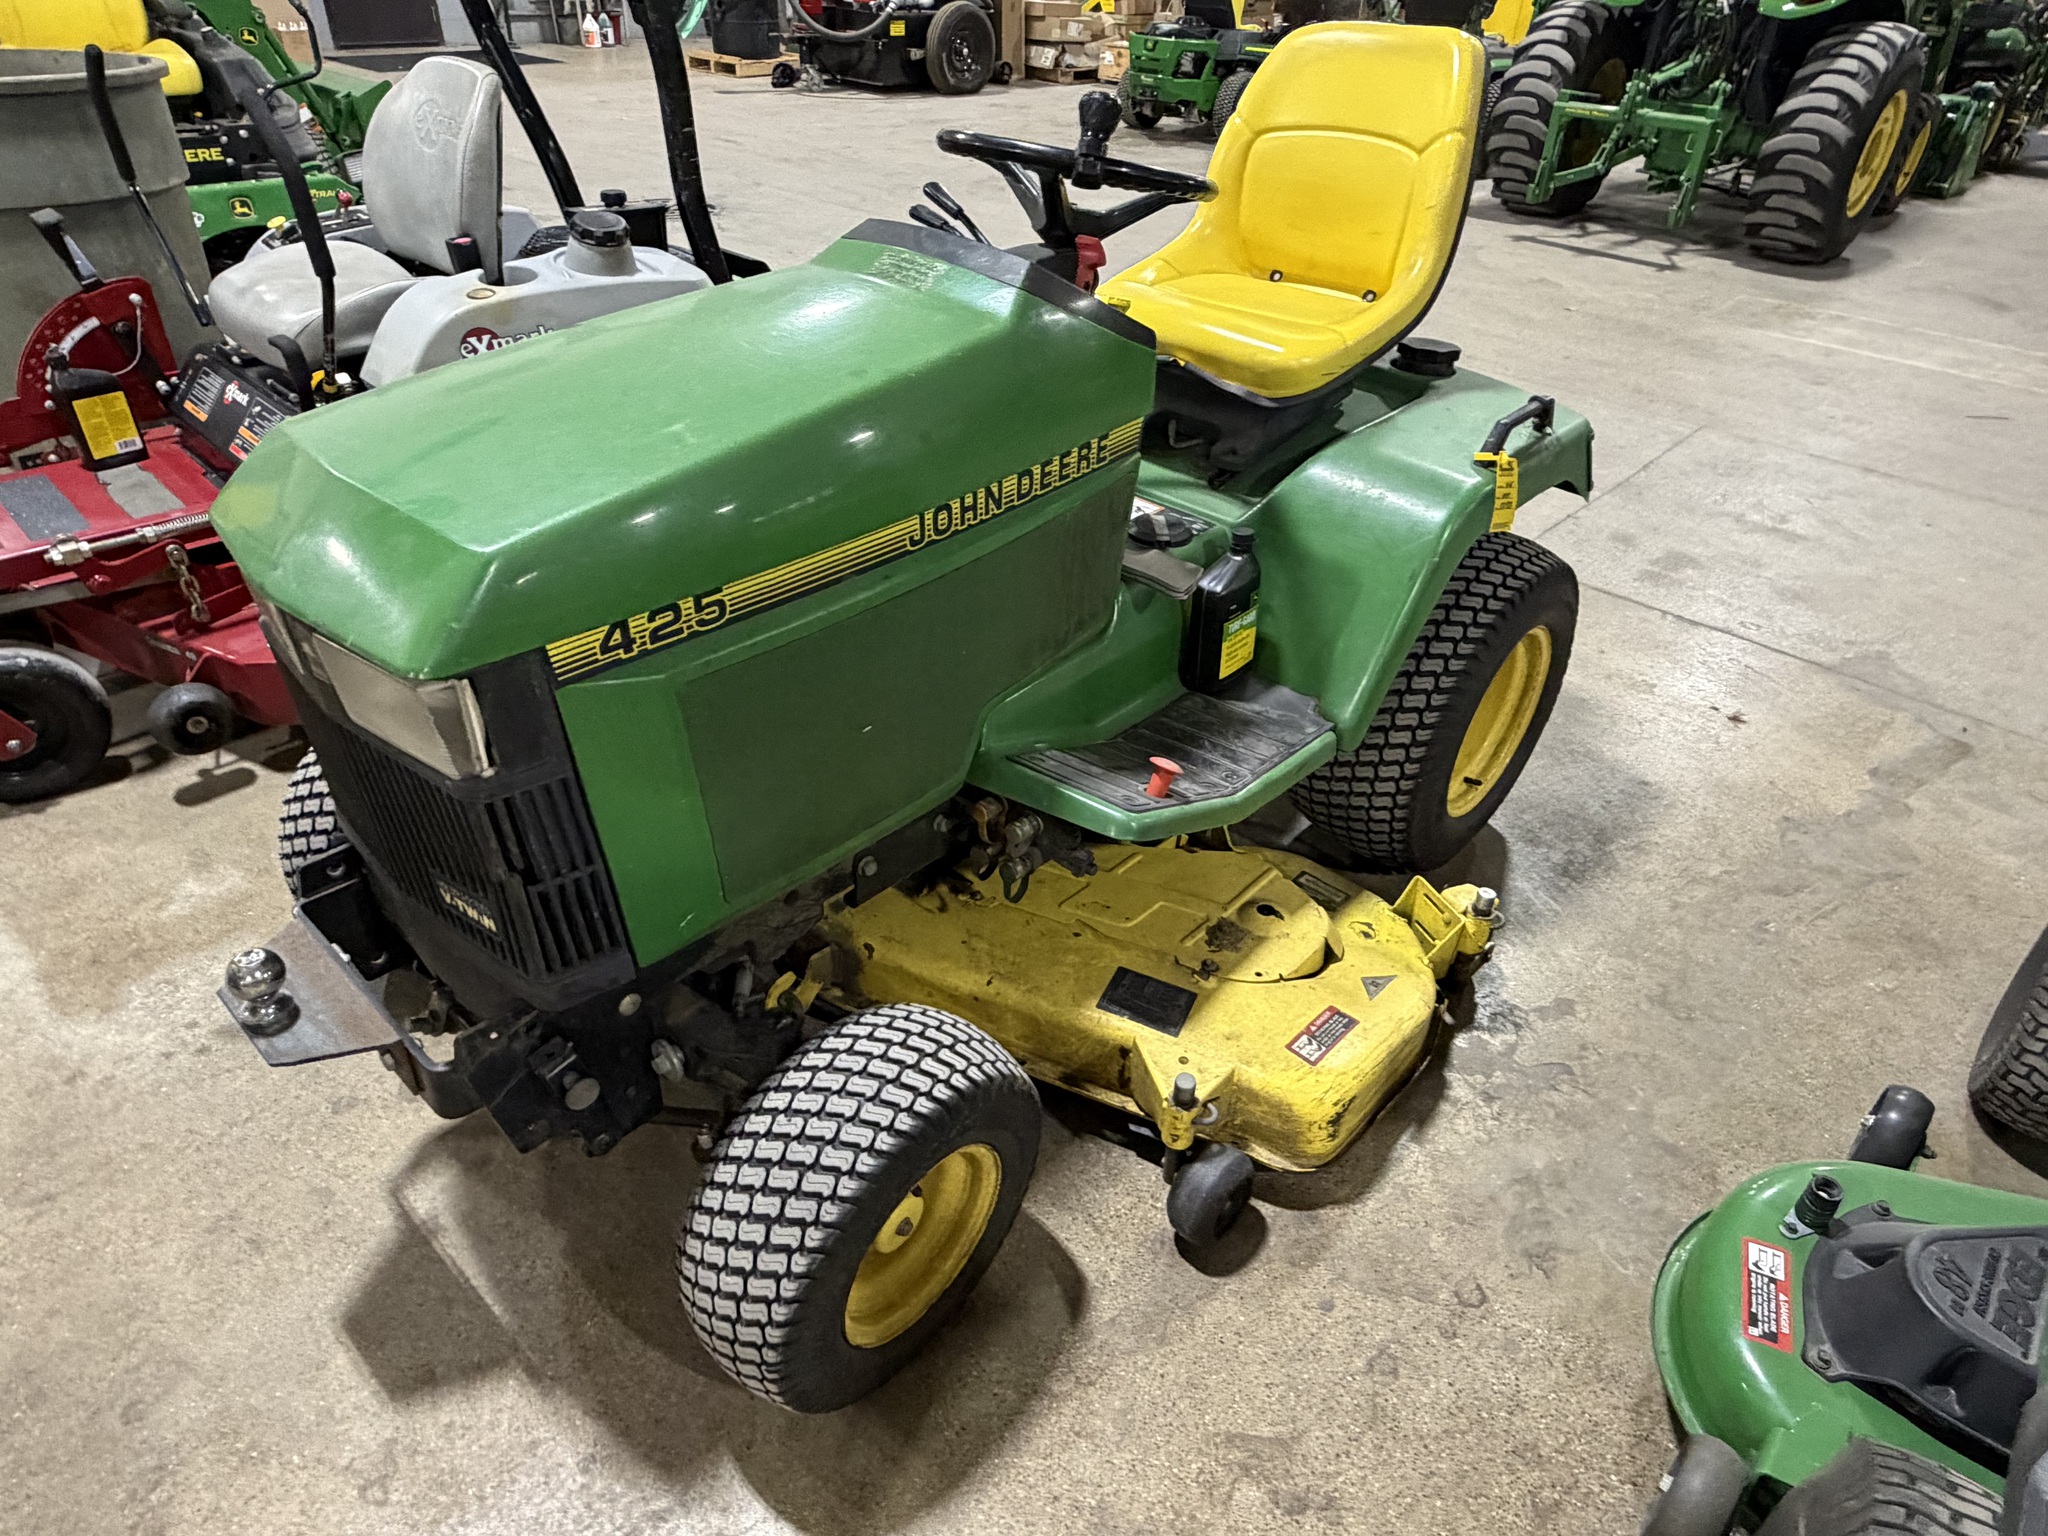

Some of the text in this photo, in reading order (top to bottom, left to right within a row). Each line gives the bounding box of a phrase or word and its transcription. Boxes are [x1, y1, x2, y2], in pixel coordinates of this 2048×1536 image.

[184, 148, 225, 162] ERE
[907, 432, 1111, 550] JOHN DEERE
[598, 585, 730, 660] 425
[1779, 1301, 1790, 1335] DANGER
